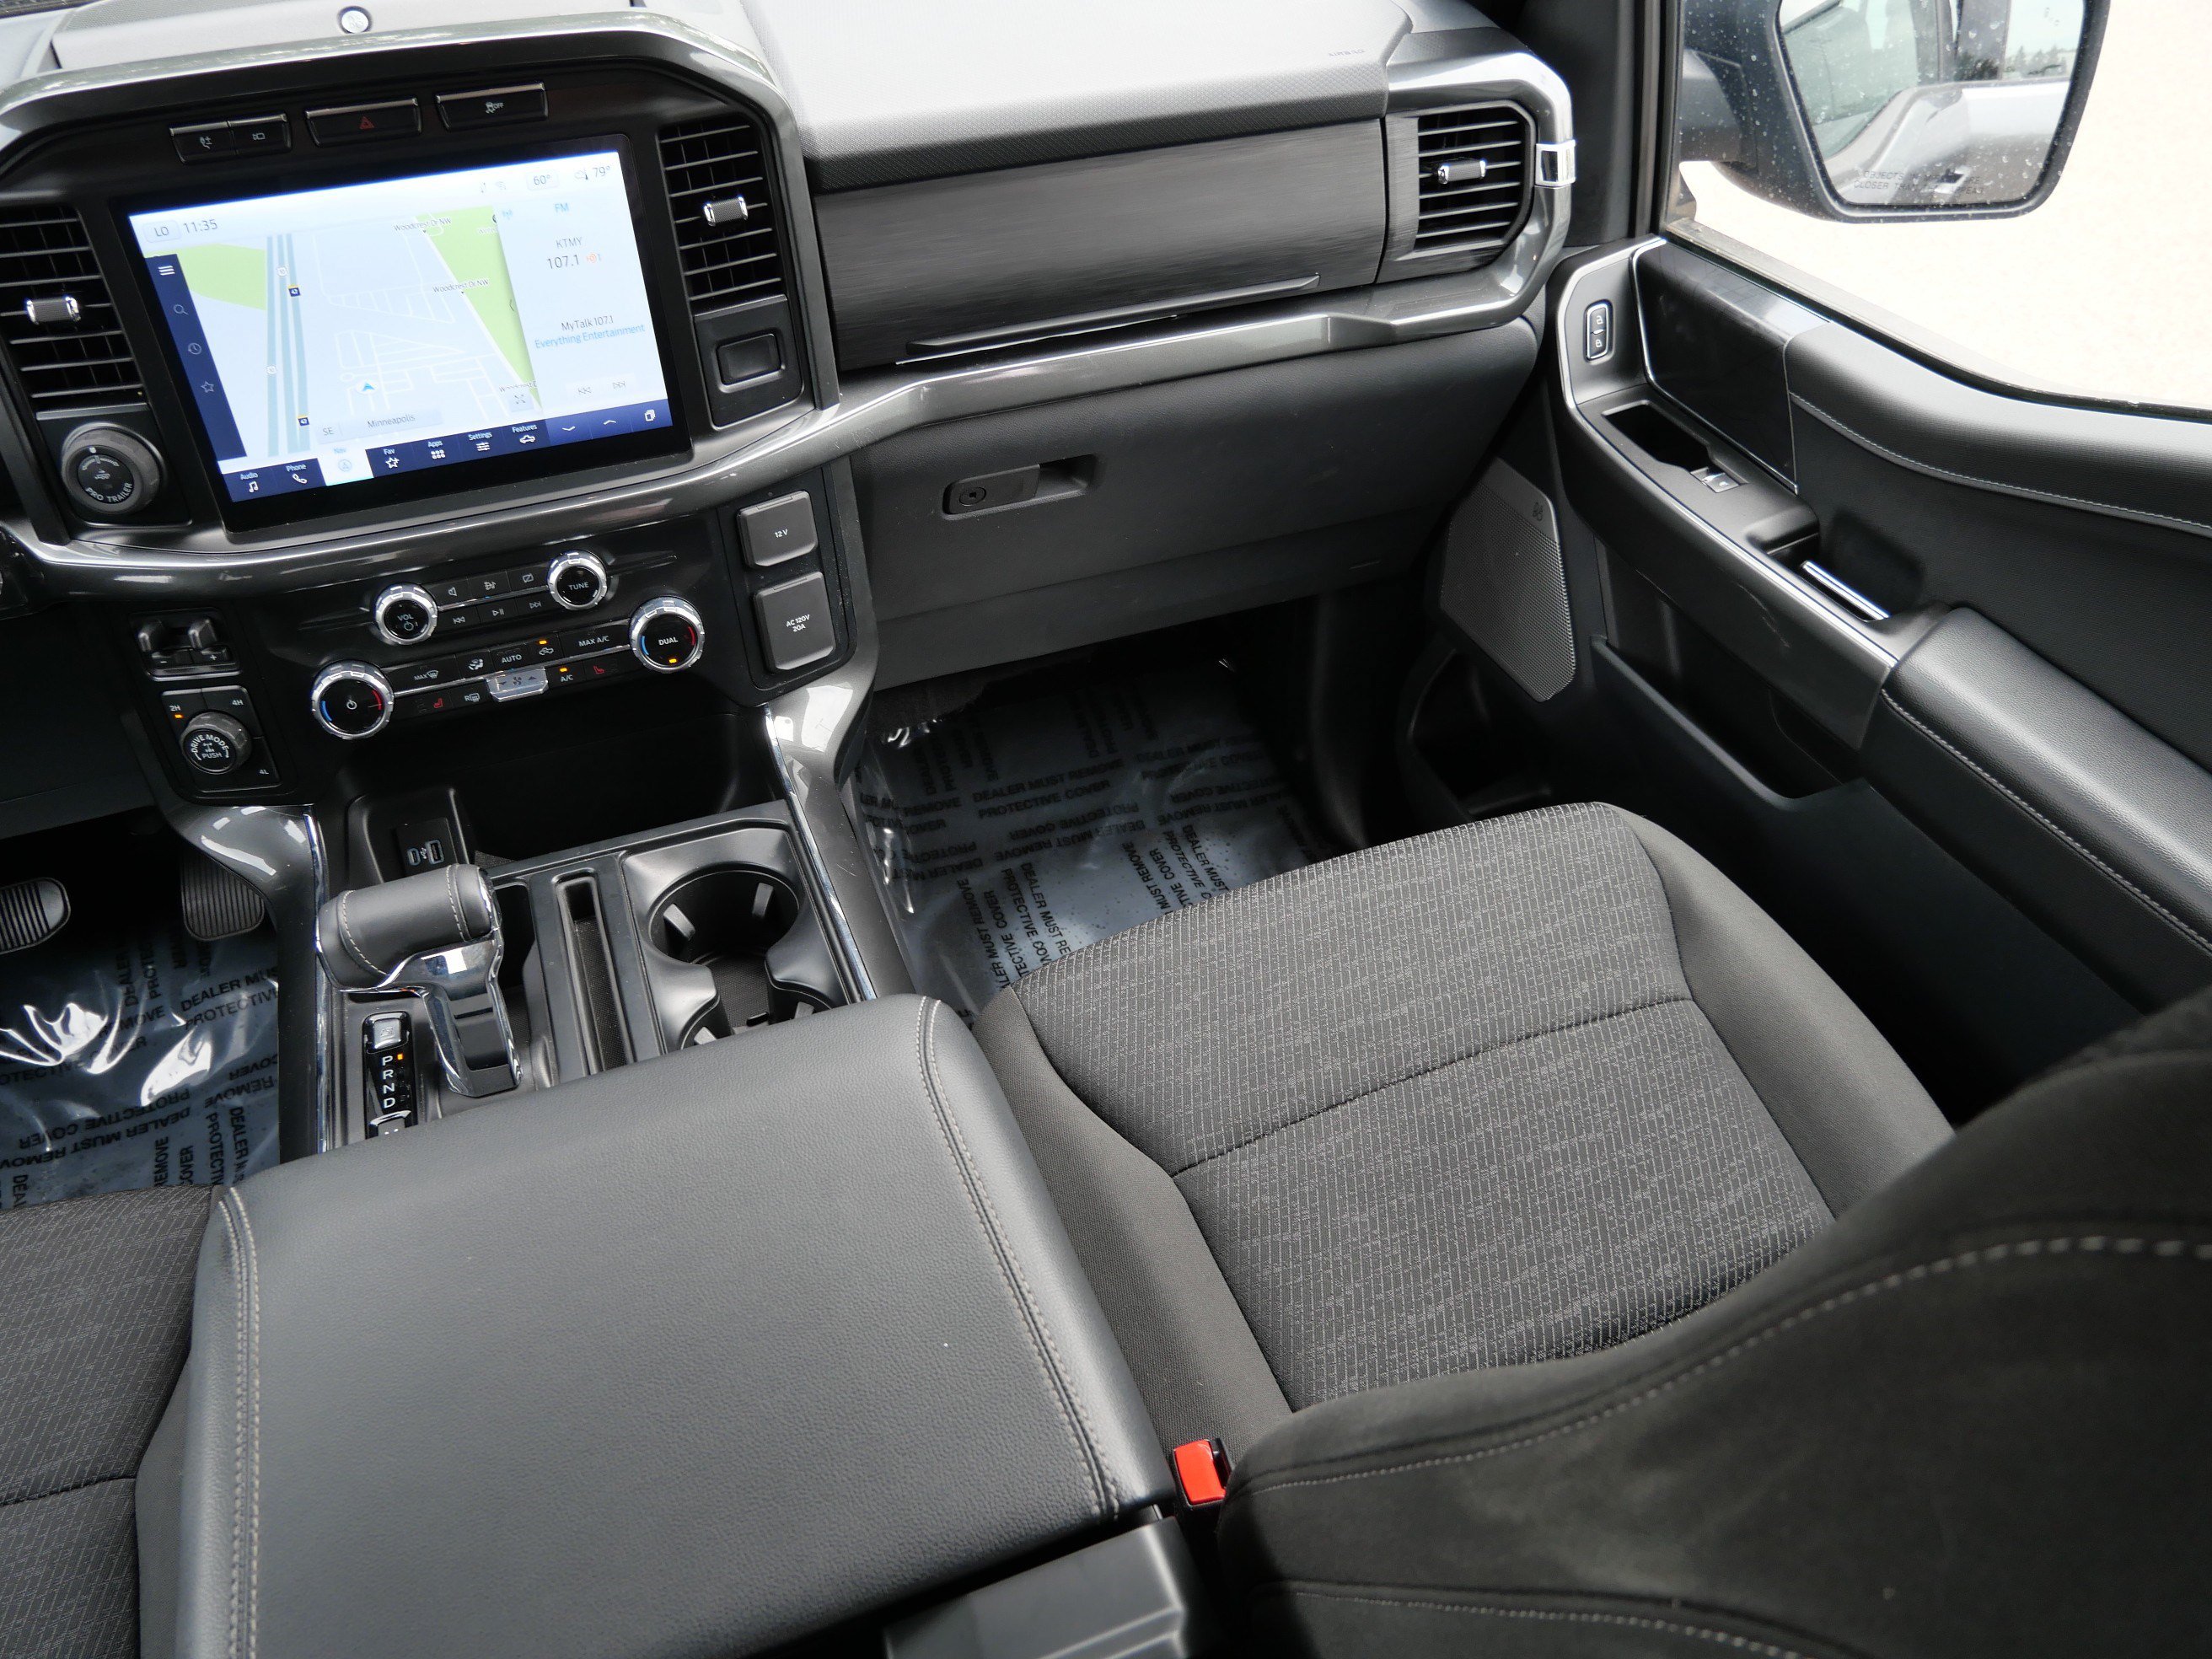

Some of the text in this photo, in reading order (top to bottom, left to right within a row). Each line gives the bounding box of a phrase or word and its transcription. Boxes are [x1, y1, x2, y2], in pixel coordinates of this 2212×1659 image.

[1854, 180, 1889, 190] CLOSER
[554, 202, 570, 212] FM
[154, 218, 218, 237] LO 11:35
[438, 217, 452, 225] NW
[556, 237, 583, 249] KTMY
[546, 254, 580, 269] 107.1
[475, 279, 489, 287] NW
[561, 319, 593, 331] MyTalk
[534, 324, 646, 349] Everything Entertainment
[367, 413, 416, 428] Minneapolis
[322, 427, 335, 436] SE
[468, 431, 493, 441] Settings
[511, 424, 537, 433] Features
[427, 439, 443, 448] Apps
[286, 464, 308, 472] Phone
[240, 472, 259, 481] Audio
[85, 481, 133, 504] PRO TRAILER
[568, 582, 589, 591] TUNE
[397, 613, 414, 621] VOL
[786, 614, 811, 628] AC 120V
[792, 623, 807, 632] 20A
[578, 636, 610, 647] MAX A/C
[658, 636, 679, 647] DUAL
[501, 653, 523, 664] AUTO
[413, 673, 428, 681] MAX
[560, 674, 574, 683] A/C
[191, 733, 229, 754] DRIVE MODE
[201, 751, 223, 760] PUSH
[972, 758, 1125, 803] DEALER MUST REMOVE
[978, 779, 1111, 819] PROTECTIVE COVER
[1008, 801, 1140, 840] PROTECTIVE COVER
[1055, 830, 1094, 849] MUST
[994, 839, 1054, 862] REMOVE
[1183, 824, 1211, 867] DEALER
[1204, 867, 1230, 892] MUST
[927, 856, 984, 878] DEALER
[1148, 847, 1176, 881] COVER
[1162, 830, 1205, 889] PROTECTIVE
[1121, 840, 1172, 910] MUST REMOVE
[956, 877, 985, 926] REMOVE
[983, 889, 1008, 929] COVER
[1001, 867, 1039, 938] PROTECTIVE
[1020, 862, 1048, 910] DEALER
[1039, 910, 1064, 942] MUST
[975, 926, 999, 960] MUST
[180, 977, 242, 1013] DEALER
[382, 1055, 394, 1066] P
[383, 1069, 394, 1080] R
[204, 1075, 275, 1109] REMOVE
[383, 1082, 395, 1094] N
[84, 1087, 191, 1131] PROTECTIVE
[384, 1097, 396, 1109] D
[126, 1106, 191, 1139] DEALER
[228, 1106, 250, 1161] DEALER
[70, 1130, 122, 1155] MUST
